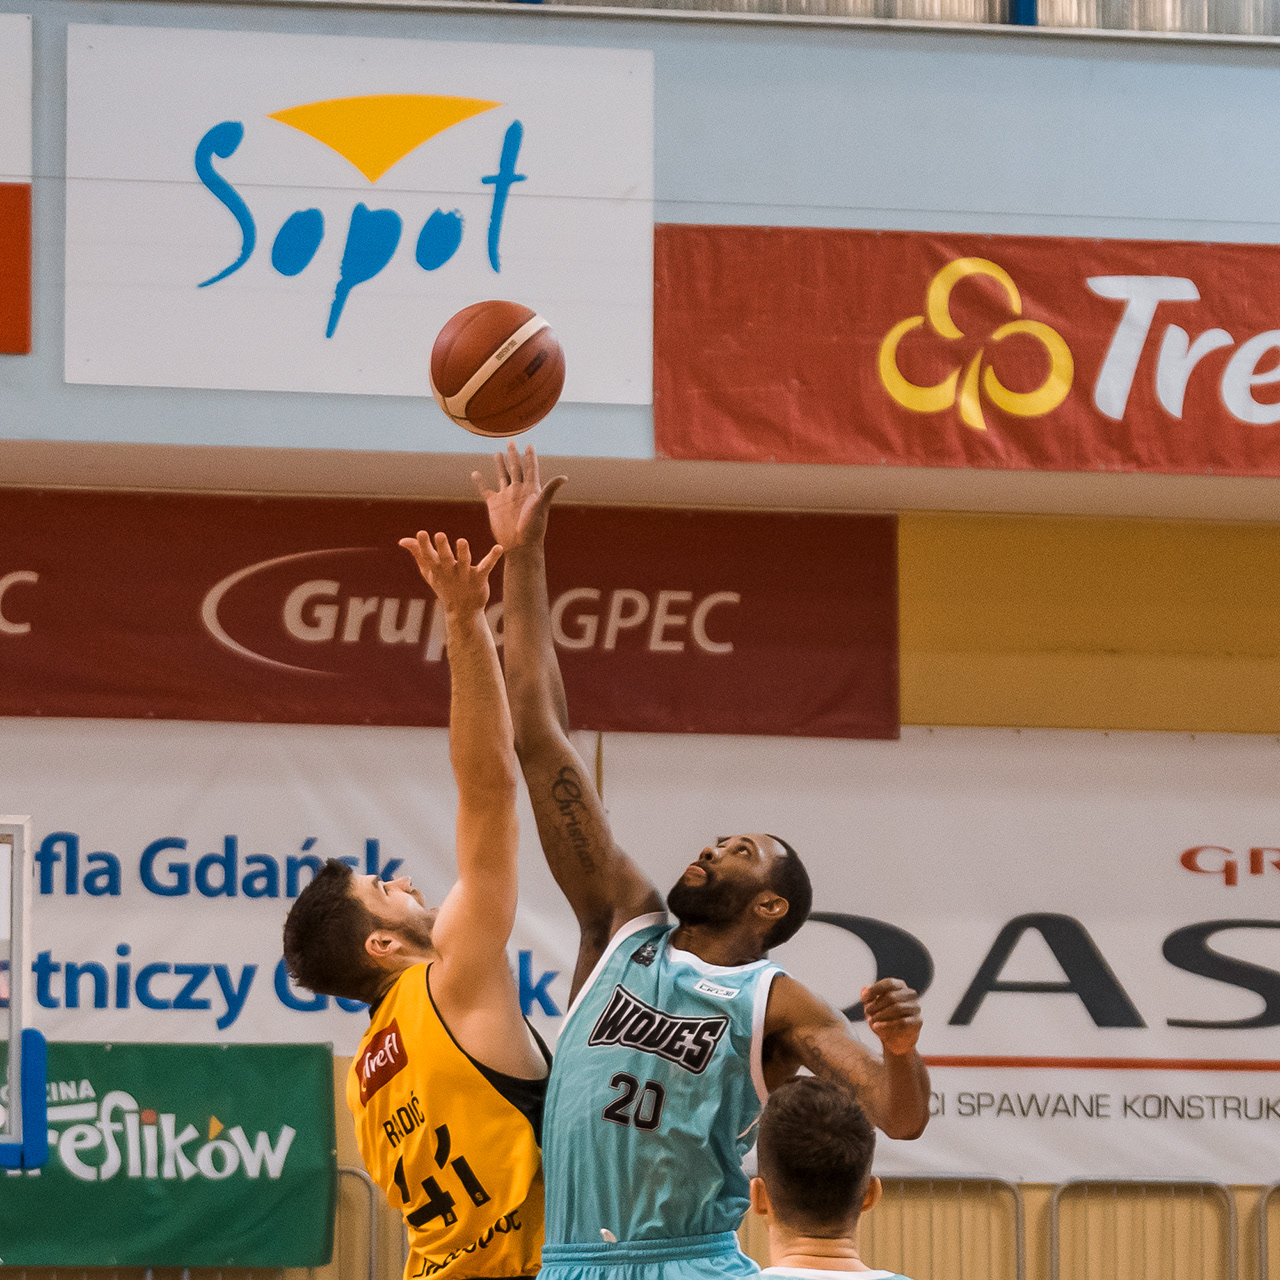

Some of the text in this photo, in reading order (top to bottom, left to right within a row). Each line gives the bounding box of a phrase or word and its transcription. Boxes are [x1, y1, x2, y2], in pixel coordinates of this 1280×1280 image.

[195, 119, 528, 339] Sopot
[550, 587, 740, 654] GPEC
[139, 835, 405, 899] Gdańk
[382, 1091, 425, 1148] RADIĆ
[602, 1071, 666, 1132] 20
[958, 1092, 1111, 1119] SPAWANE
[6, 1090, 296, 1182] eflików
[393, 1124, 491, 1227] 41
